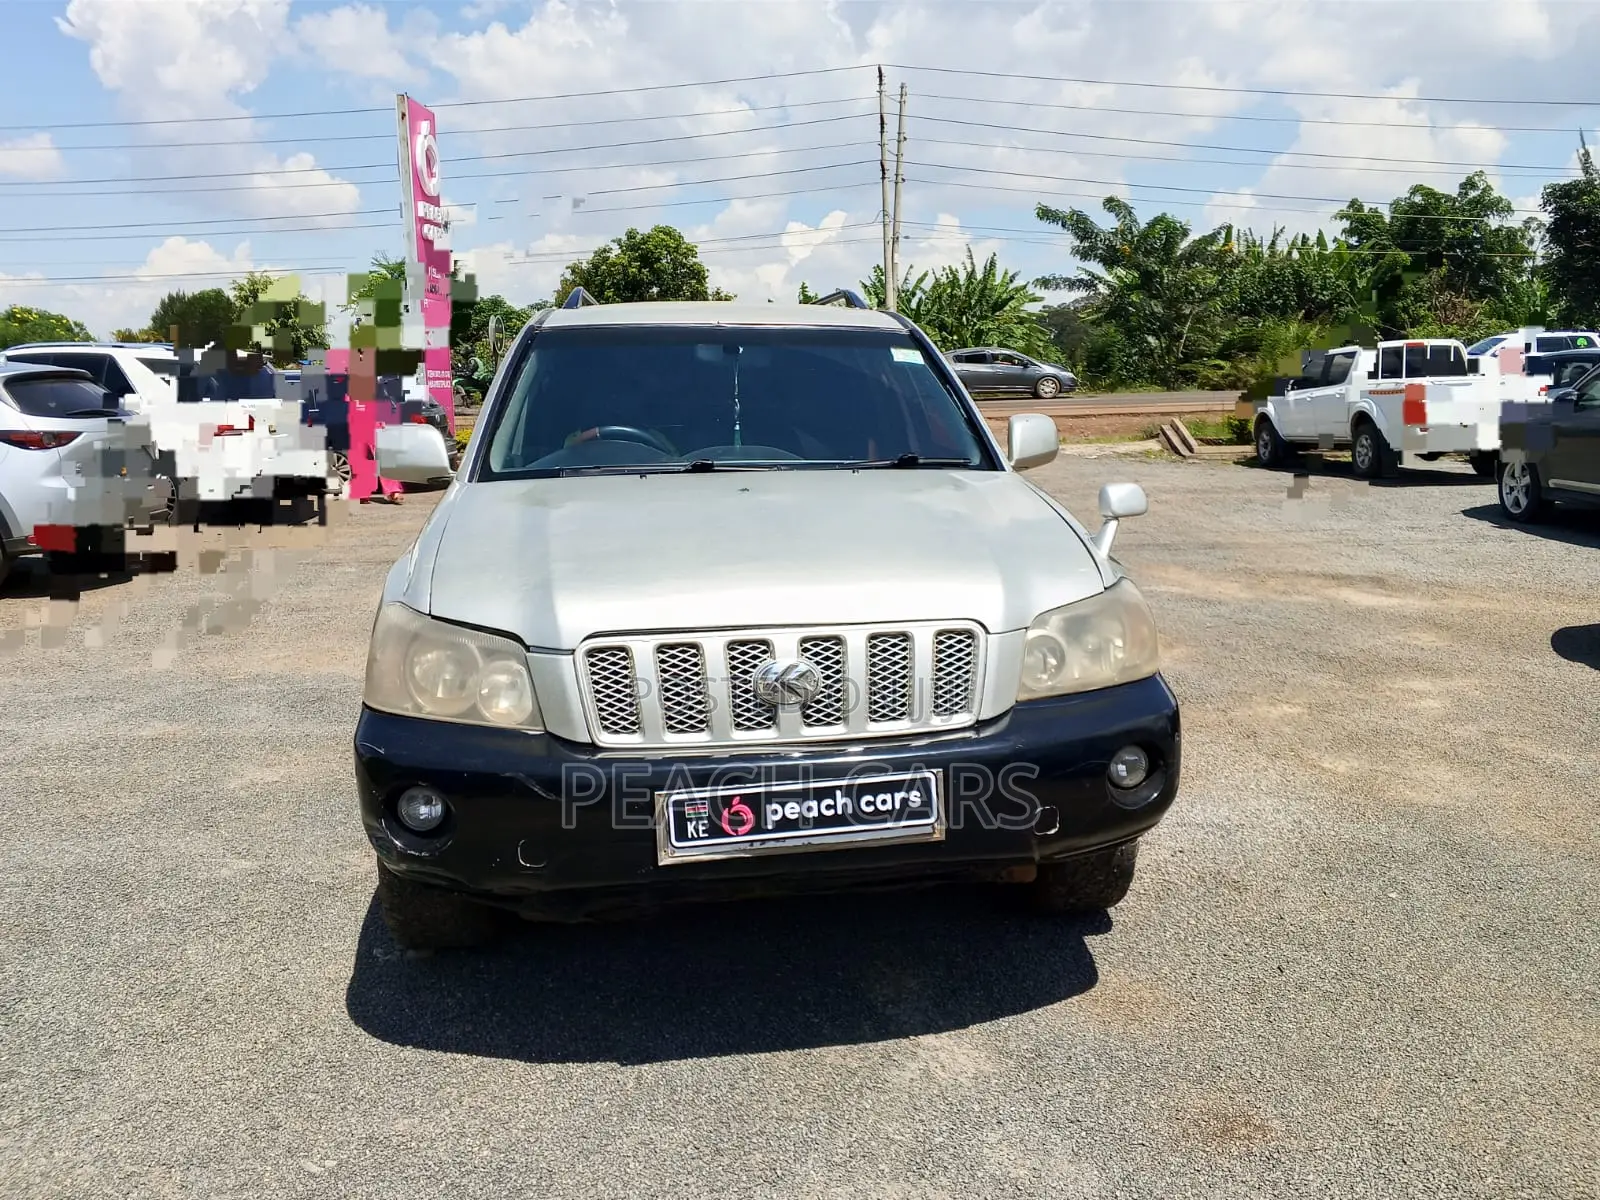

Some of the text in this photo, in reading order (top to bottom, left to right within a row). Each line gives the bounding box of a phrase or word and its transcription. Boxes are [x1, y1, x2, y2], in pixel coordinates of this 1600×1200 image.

[767, 790, 922, 829] peach cars
[687, 820, 709, 839] KE
